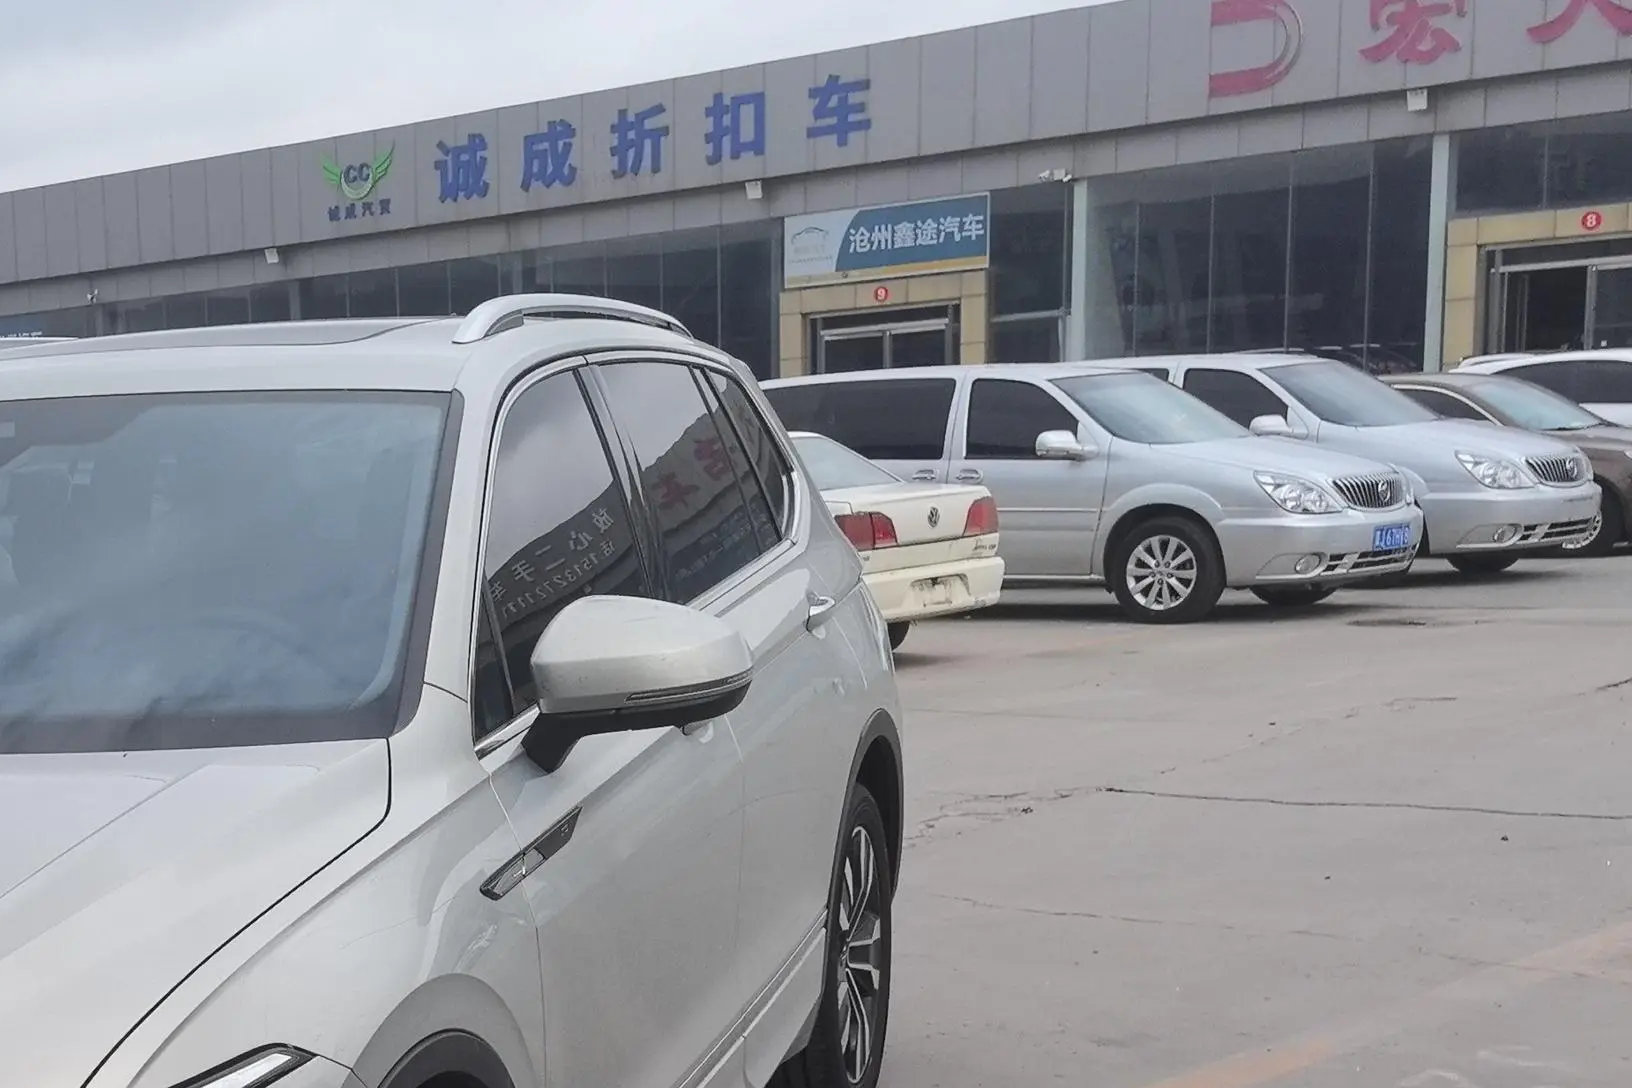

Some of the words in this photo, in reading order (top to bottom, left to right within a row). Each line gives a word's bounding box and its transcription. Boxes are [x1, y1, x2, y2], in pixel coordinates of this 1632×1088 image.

[434, 74, 872, 203] 诚成折扣车
[849, 213, 985, 253] 沧州鑫途汽车
[1586, 214, 1597, 228] 8
[876, 286, 886, 300] 9
